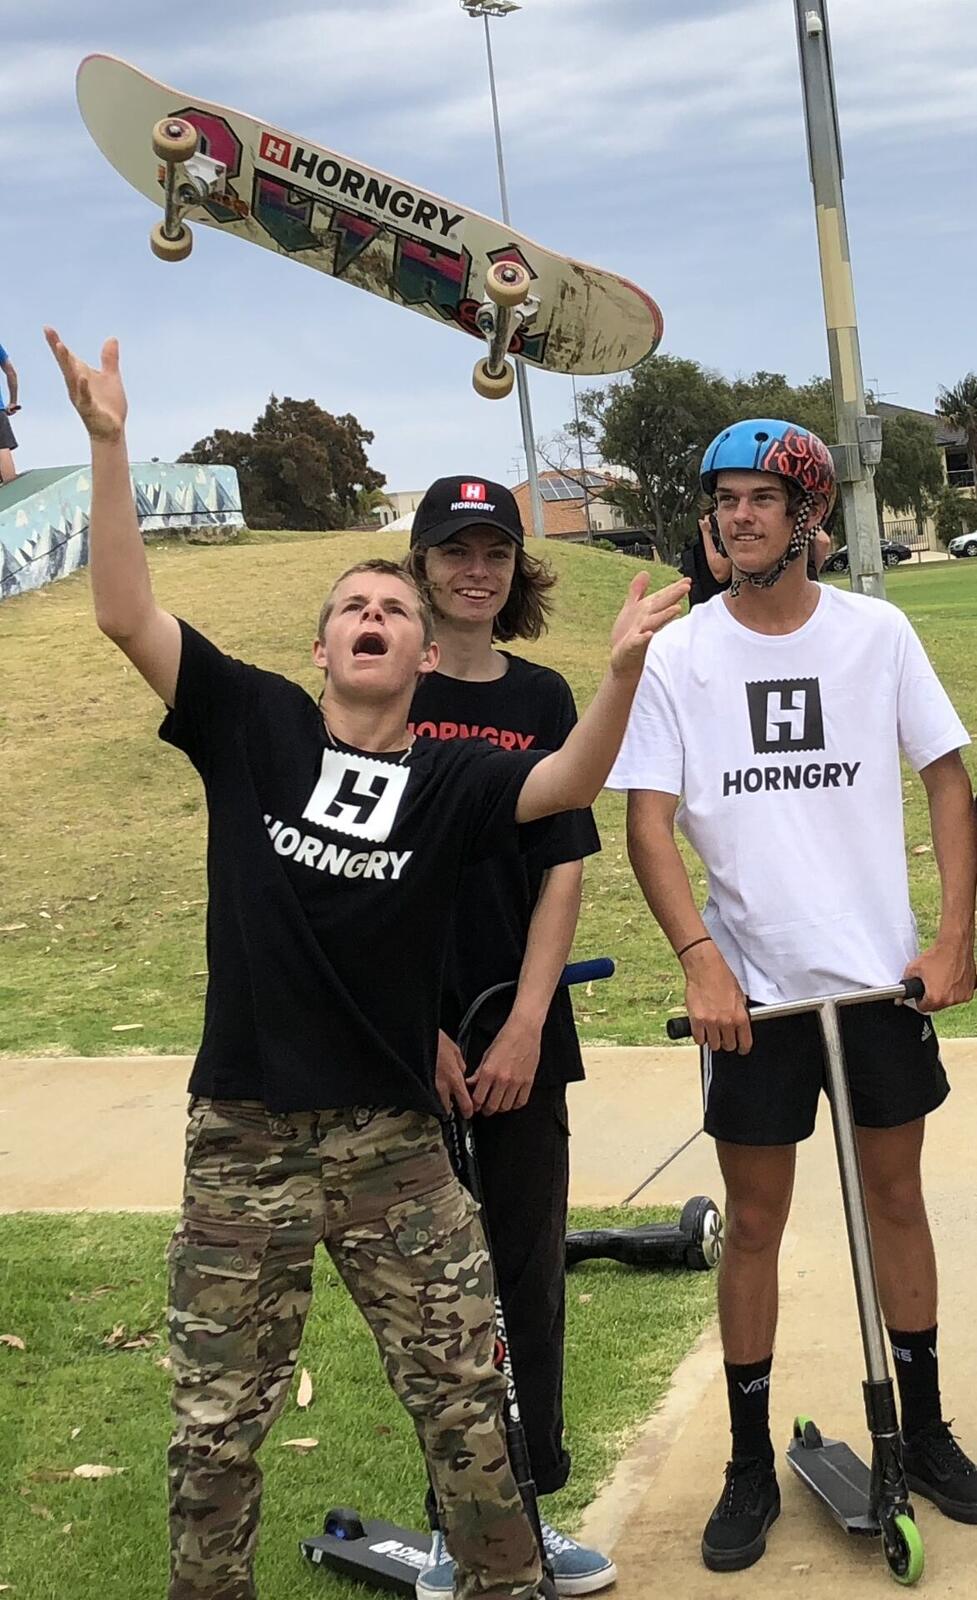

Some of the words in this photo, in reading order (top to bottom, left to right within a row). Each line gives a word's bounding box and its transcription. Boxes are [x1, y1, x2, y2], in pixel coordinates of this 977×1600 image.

[290, 146, 464, 236] HORNGRY
[450, 501, 496, 512] HORNGRY
[407, 721, 535, 751] ORNGRY
[723, 761, 861, 797] HORNGRY
